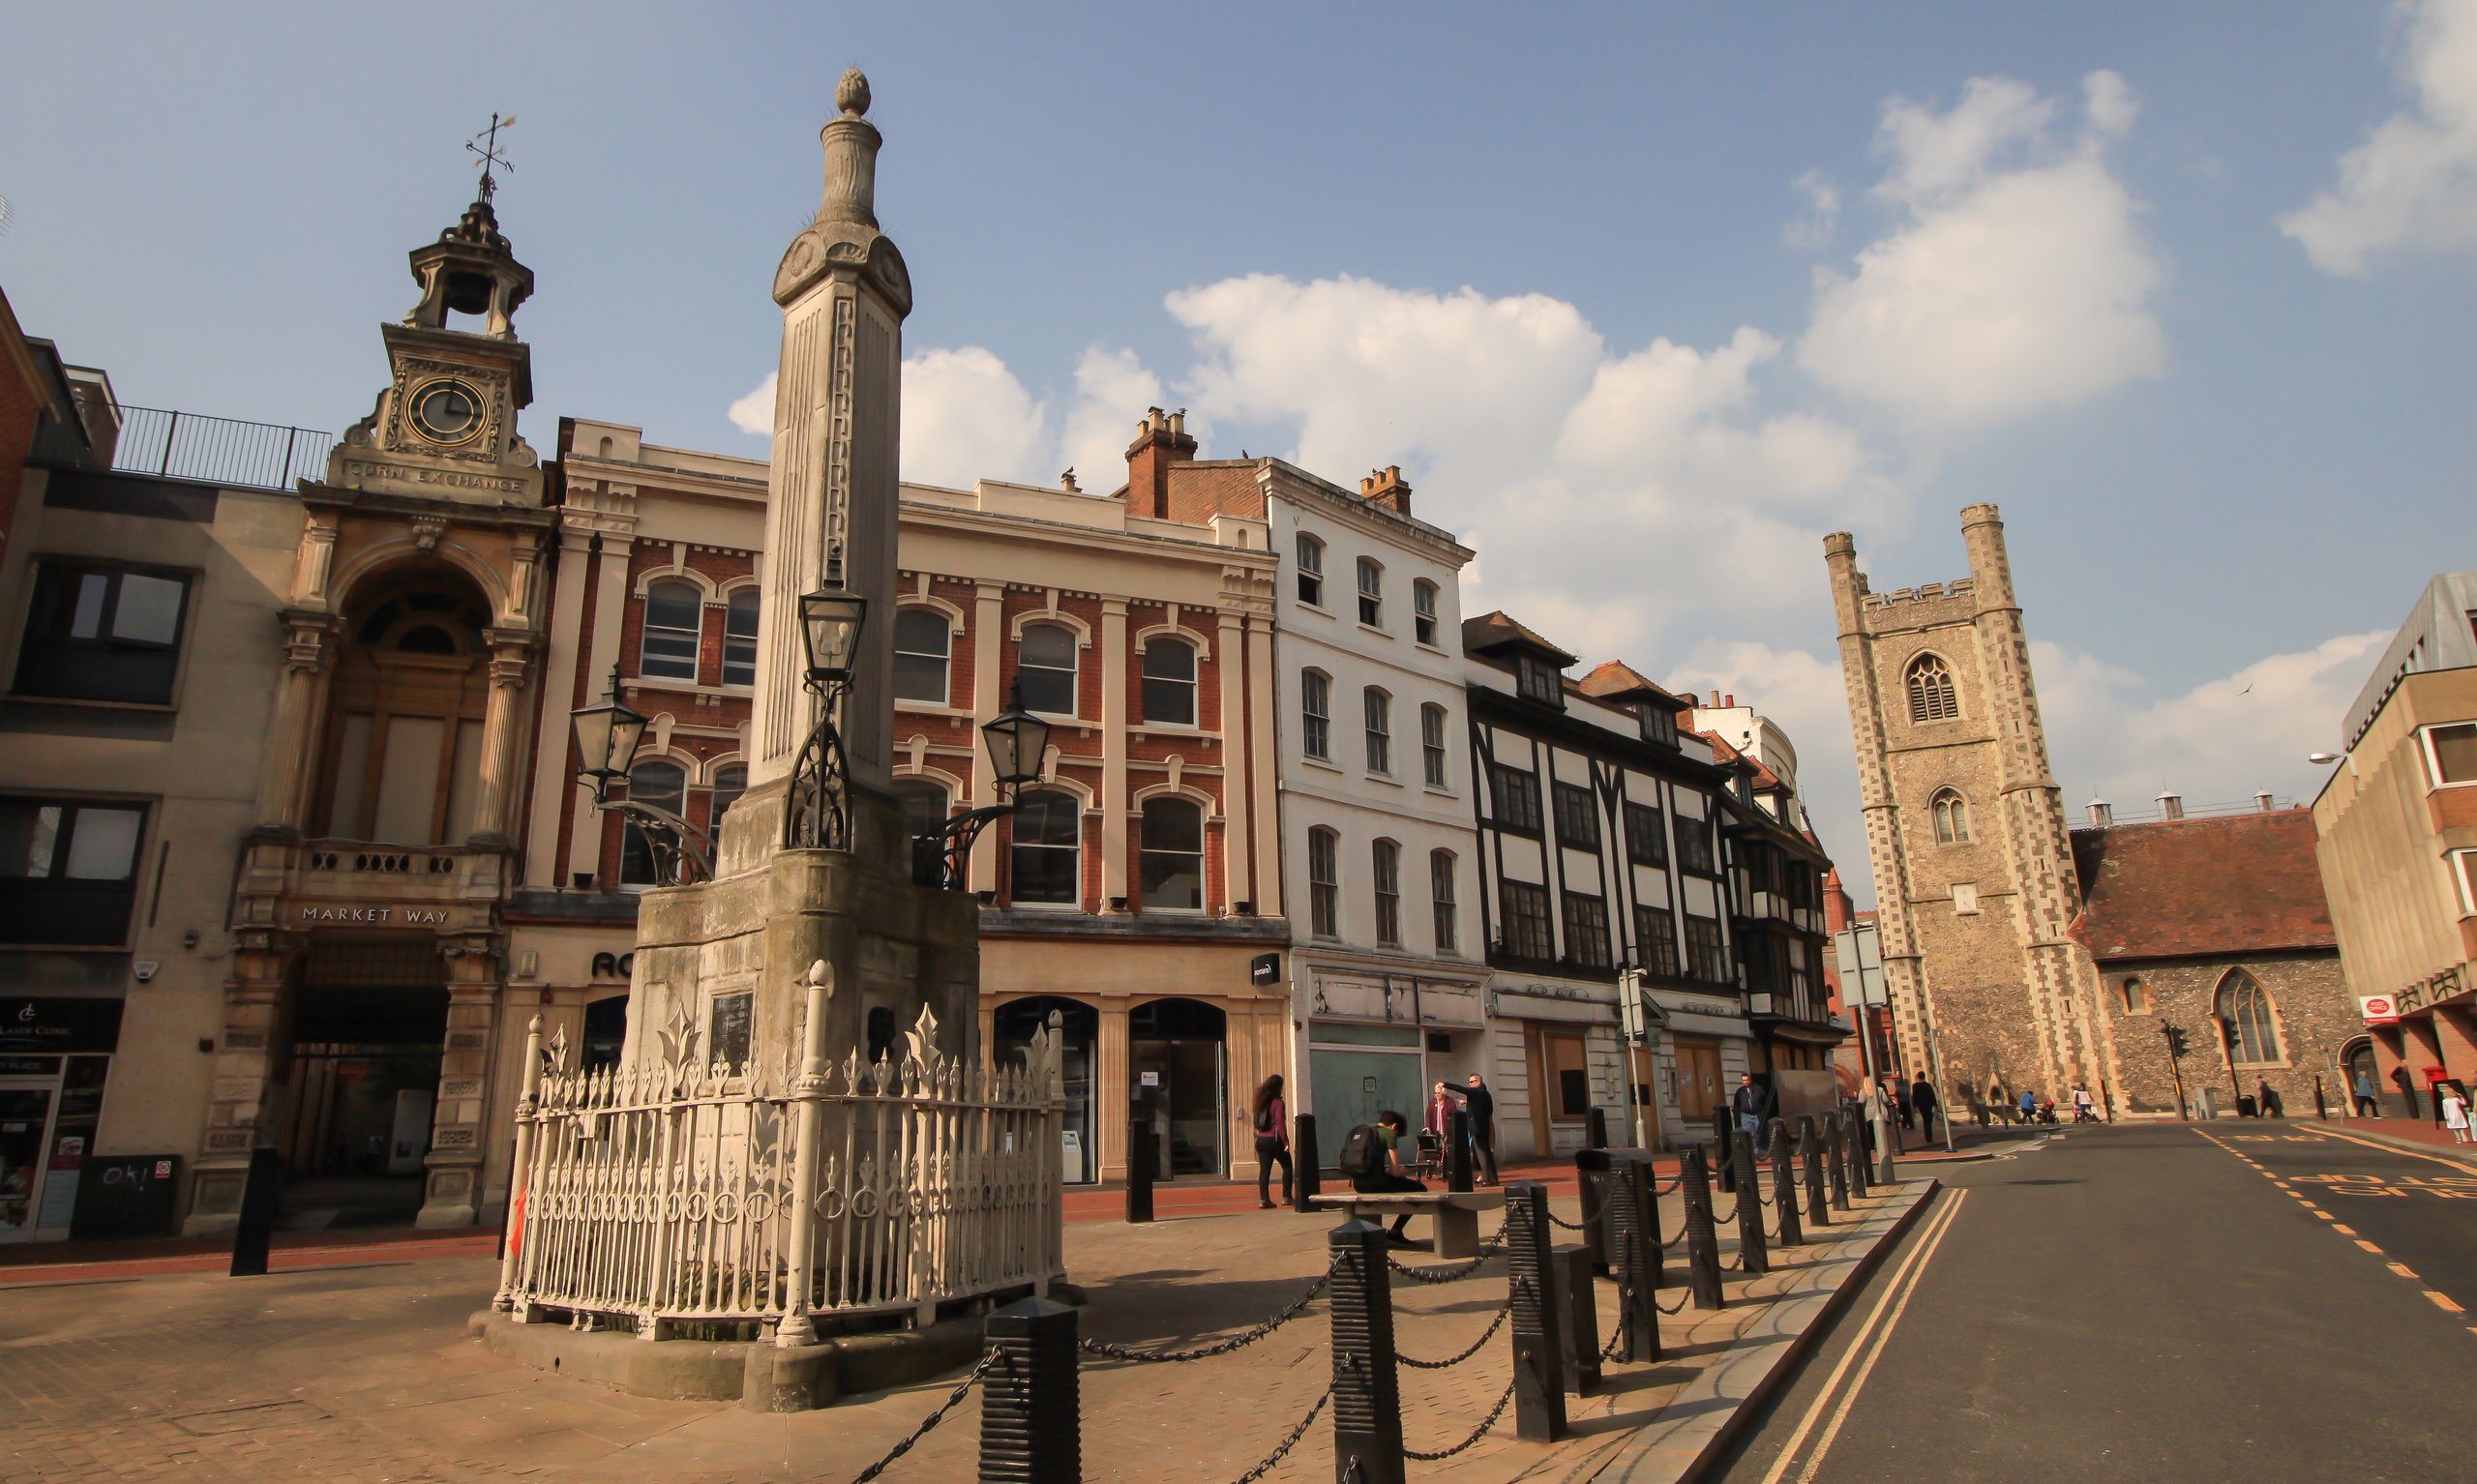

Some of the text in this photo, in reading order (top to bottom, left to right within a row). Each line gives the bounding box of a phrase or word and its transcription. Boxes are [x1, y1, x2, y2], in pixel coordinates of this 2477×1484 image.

[349, 462, 522, 493] CORN EXCHANGE
[302, 906, 448, 923] MARKET WAY
